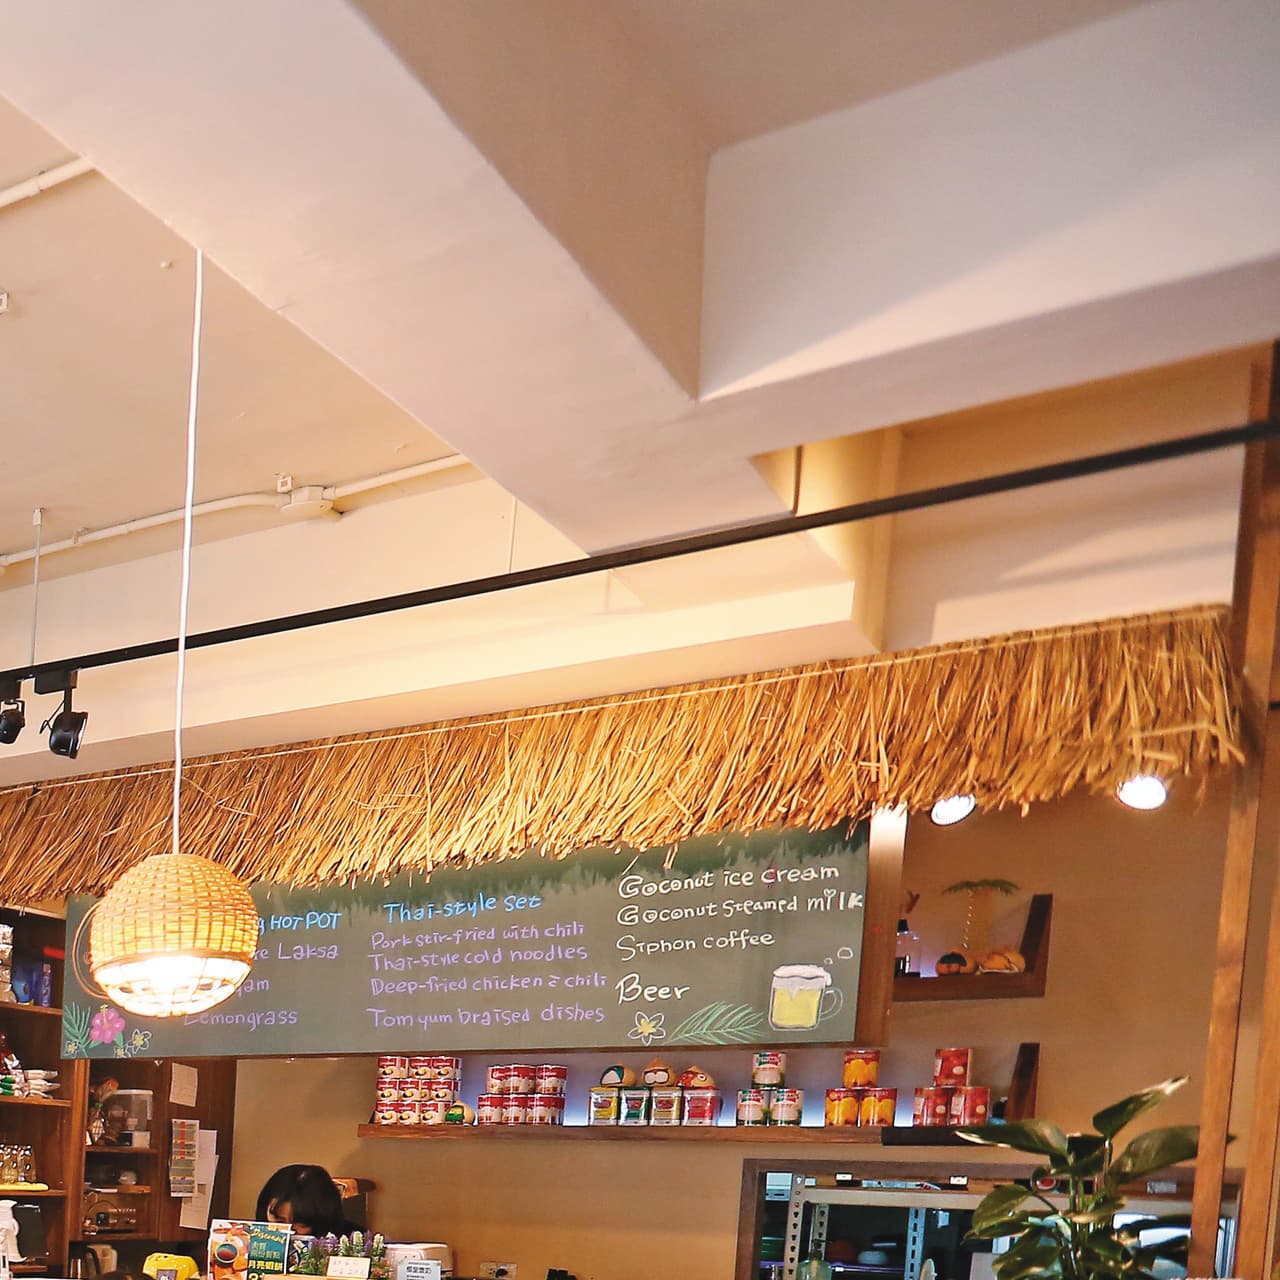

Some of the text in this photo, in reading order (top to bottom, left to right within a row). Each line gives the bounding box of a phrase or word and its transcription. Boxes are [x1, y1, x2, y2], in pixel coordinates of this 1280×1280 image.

[724, 870, 753, 886] ice
[761, 867, 839, 885] cream
[384, 892, 542, 924] Thai-style set
[807, 889, 864, 911] milk
[270, 914, 304, 931] HOT
[305, 911, 342, 929] POT
[371, 932, 412, 950] Pork
[503, 924, 539, 939] with
[544, 921, 585, 938] chili
[616, 929, 776, 961] Siphon coffee
[278, 942, 338, 960] Laksa
[464, 948, 502, 964] cold
[510, 944, 588, 963] noodles
[370, 976, 467, 996] Deep-fried
[472, 975, 542, 992] chicken
[565, 972, 607, 988] chili
[615, 973, 690, 1004] Beer
[366, 1002, 606, 1031] Tom yum braised dishes
